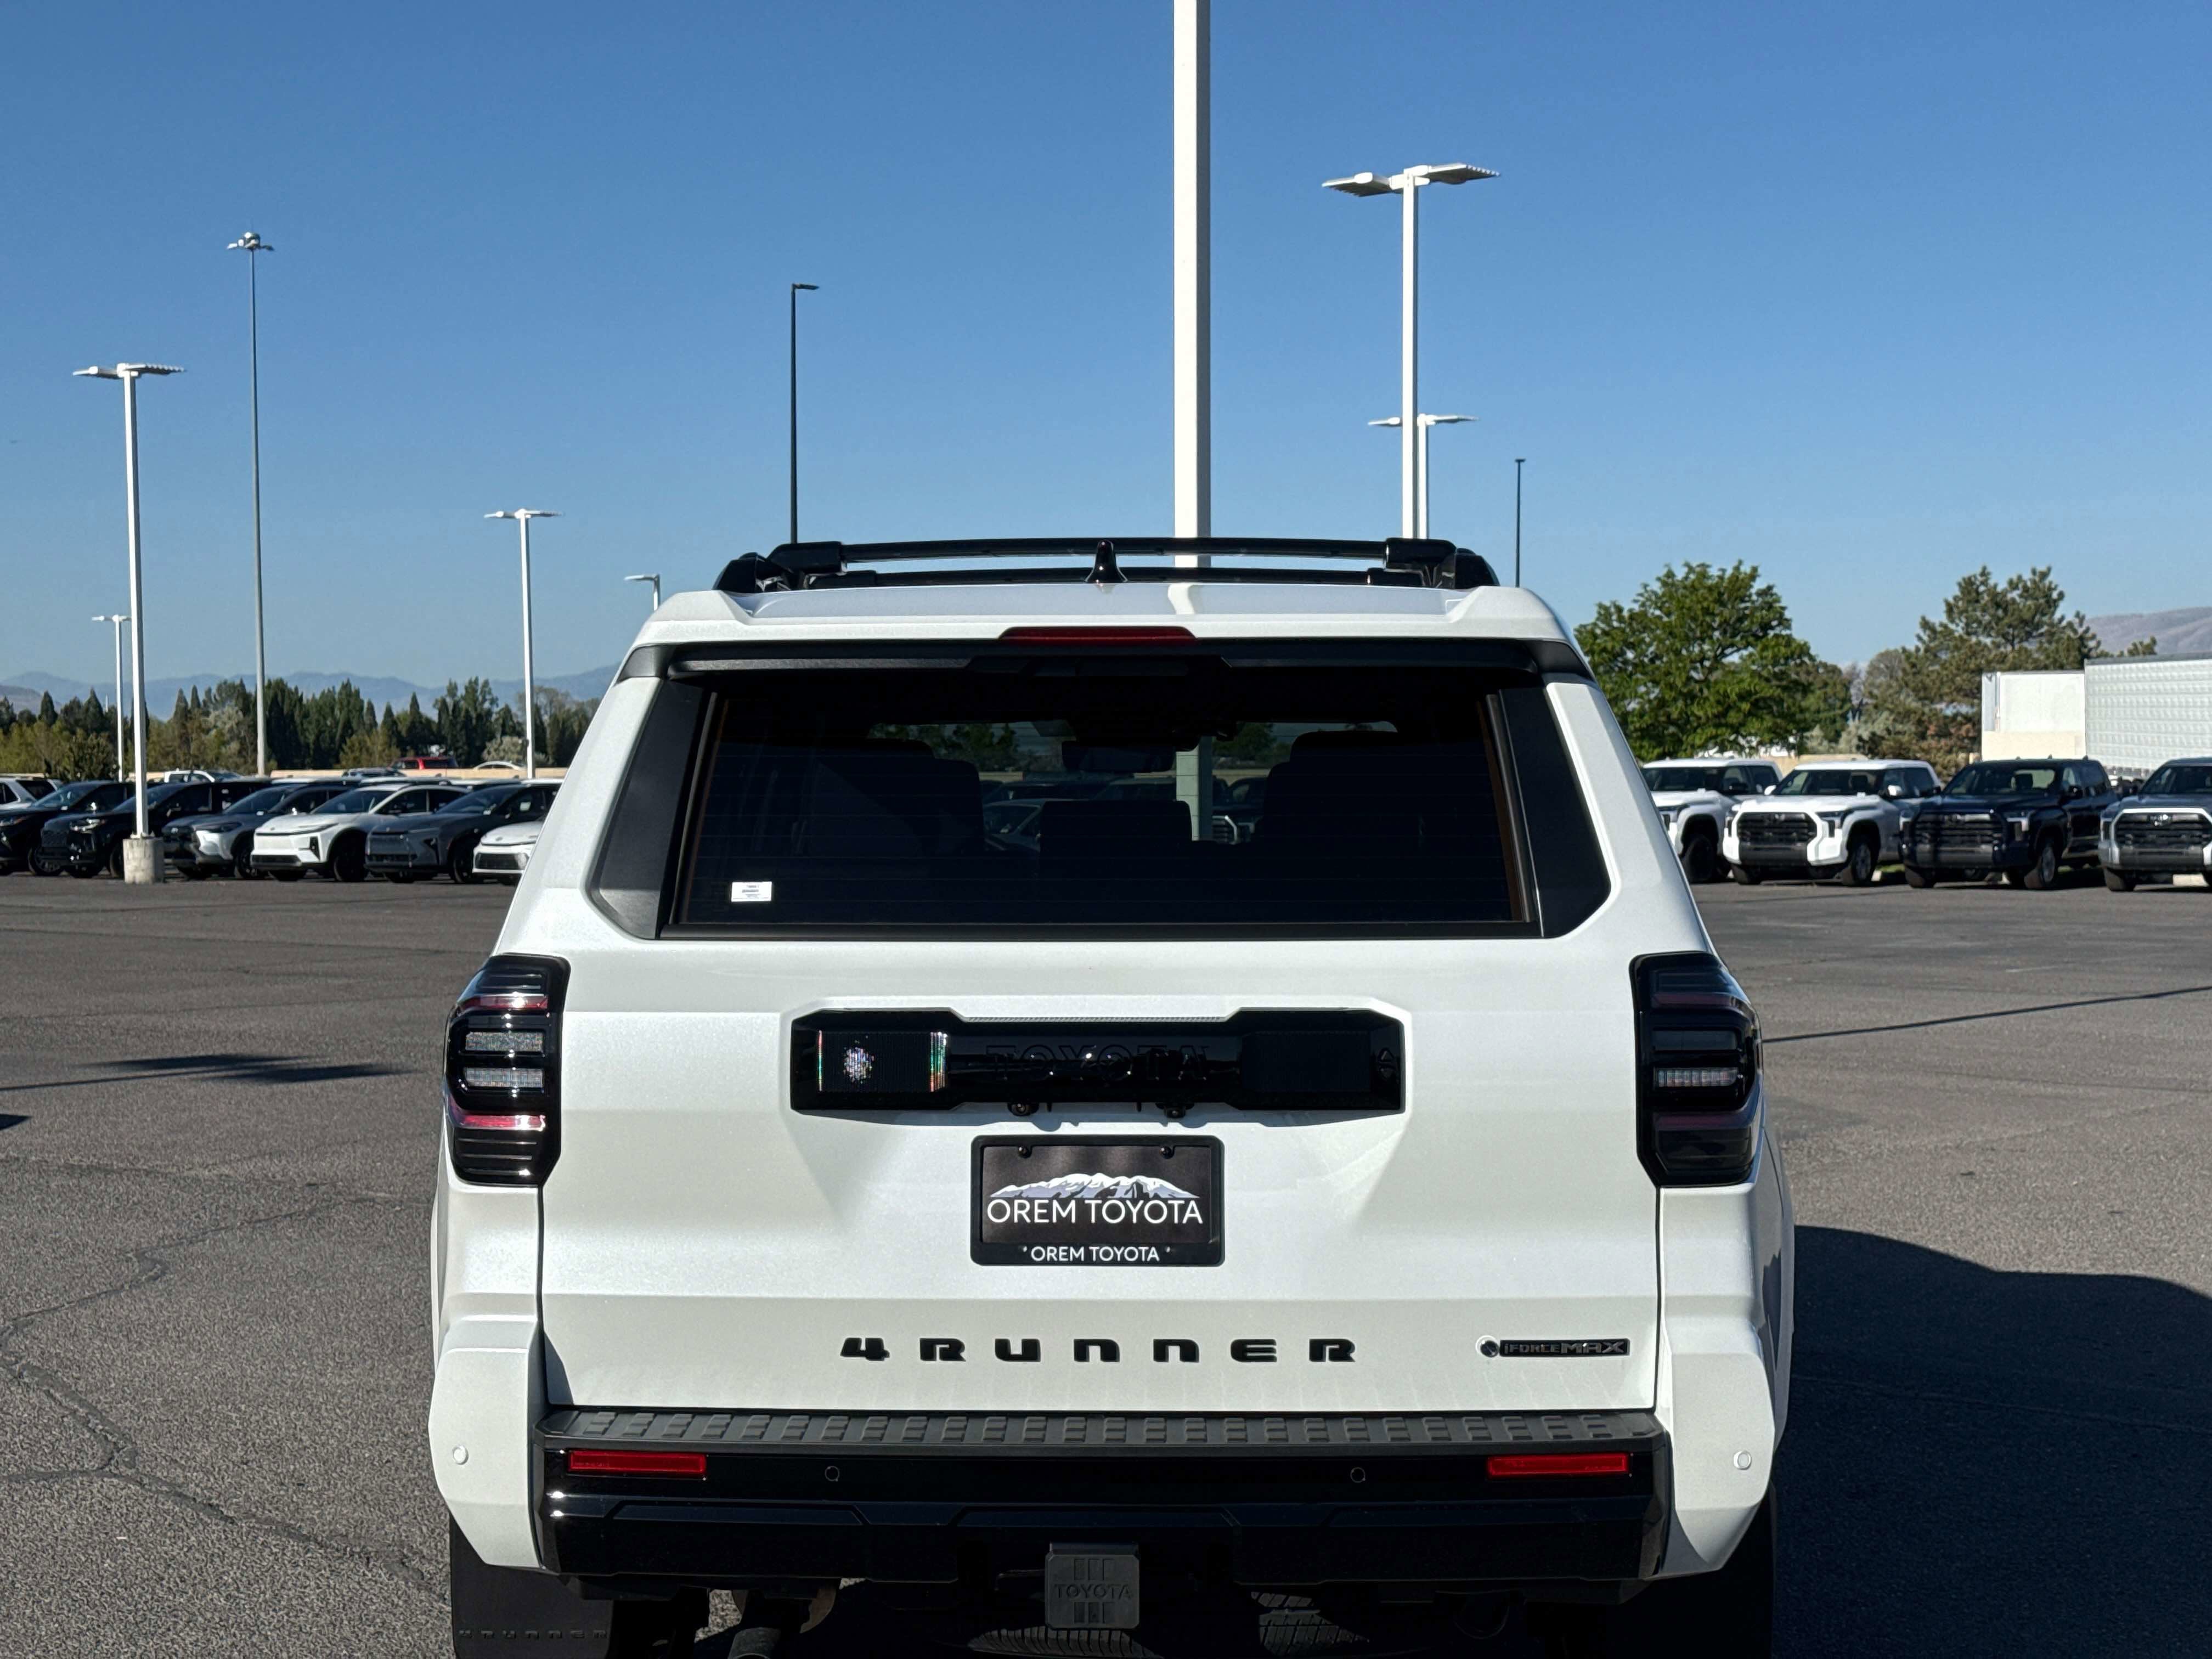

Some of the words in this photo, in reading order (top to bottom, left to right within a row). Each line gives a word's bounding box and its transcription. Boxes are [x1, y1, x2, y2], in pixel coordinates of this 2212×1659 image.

[986, 1045, 1209, 1080] TOYOTA
[987, 1199, 1076, 1224] OREM
[1084, 1199, 1203, 1224] TOYOTA
[1030, 1245, 1084, 1262] OREM
[1088, 1245, 1160, 1262] TOYOTA
[840, 1337, 1356, 1363] 4RUNNER
[1053, 1583, 1133, 1599] TOYOTA
